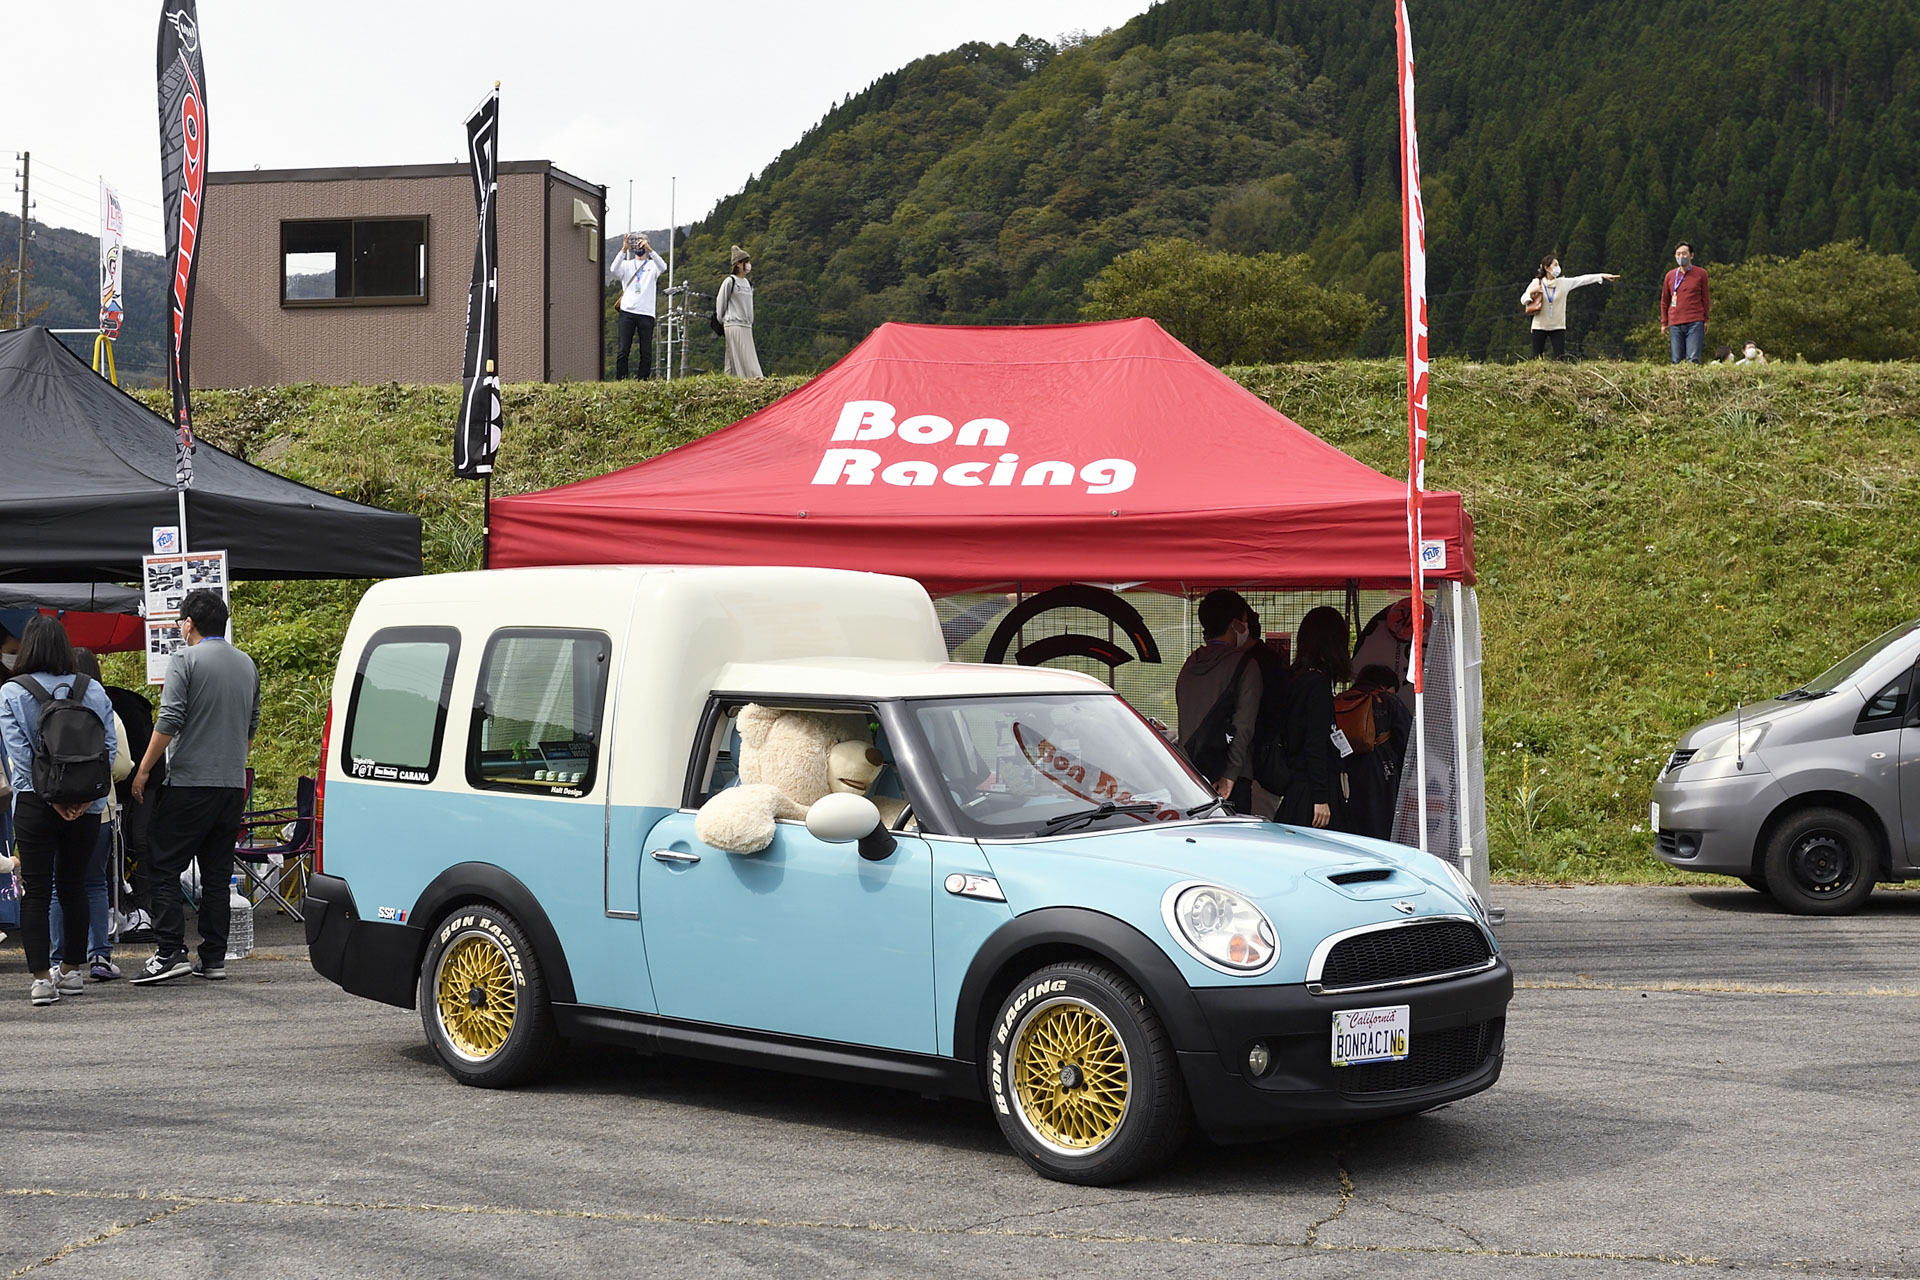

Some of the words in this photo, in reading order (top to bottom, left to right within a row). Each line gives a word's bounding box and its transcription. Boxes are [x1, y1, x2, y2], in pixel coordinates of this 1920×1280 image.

[830, 400, 1010, 447] Bon
[810, 448, 1137, 494] Racing
[378, 906, 396, 920] SSR
[441, 915, 475, 944] BON
[479, 918, 526, 987] RACING
[997, 979, 1067, 1044] RACING
[1349, 1011, 1395, 1029] California
[1336, 1028, 1405, 1059] BONRACING
[992, 1050, 1010, 1115] BON
